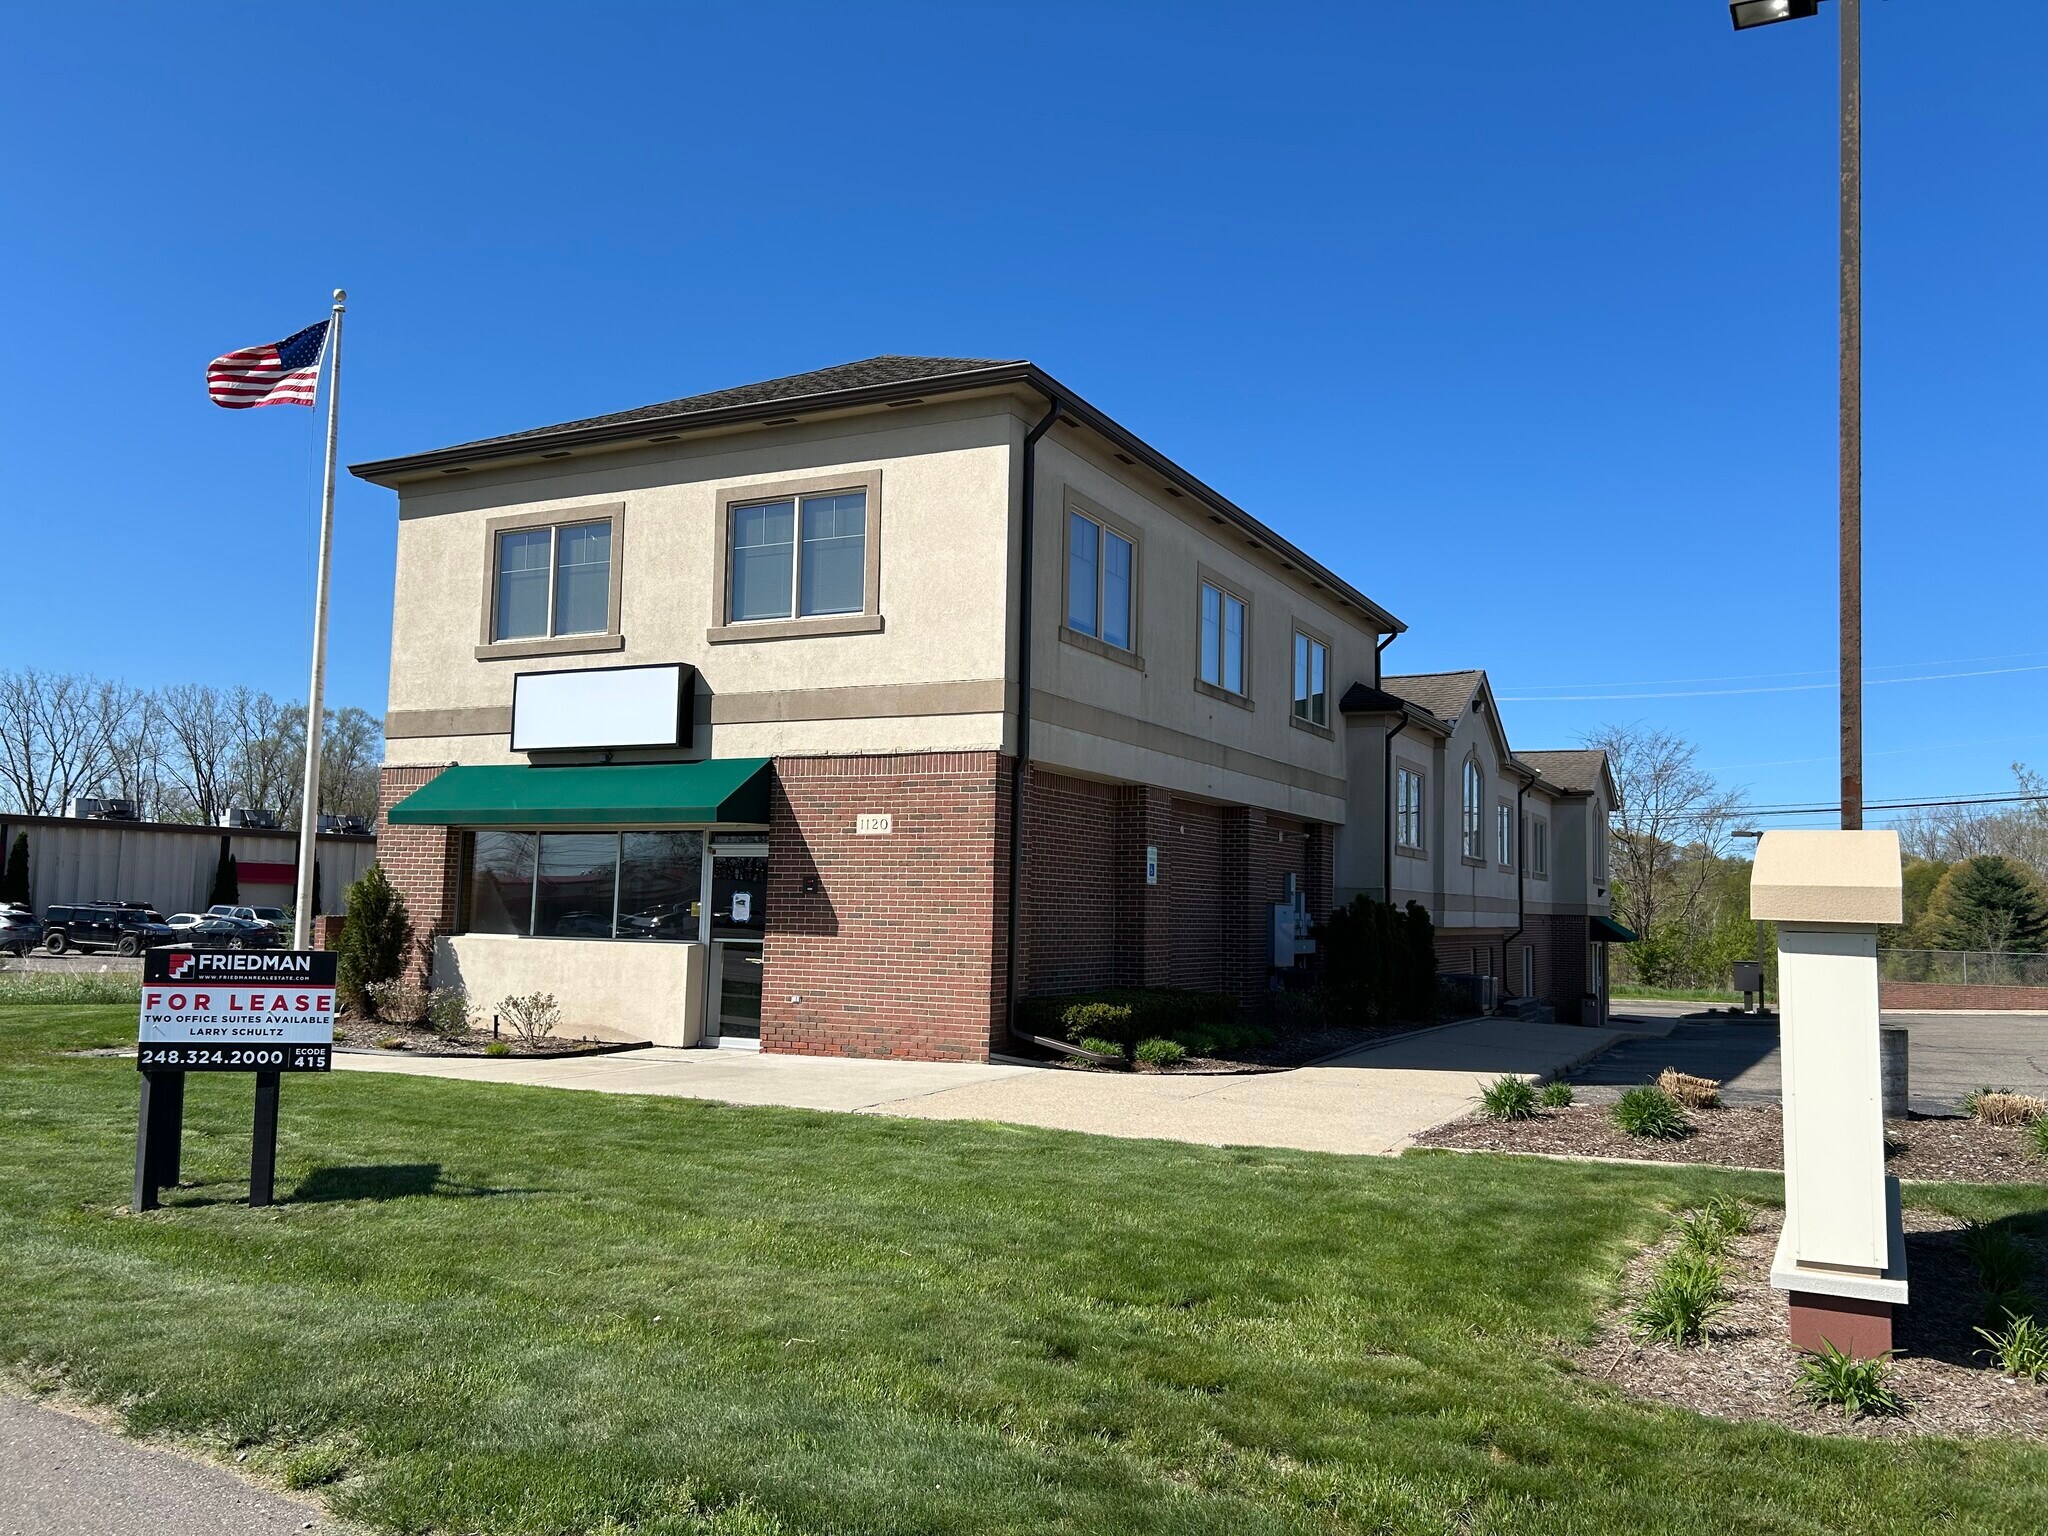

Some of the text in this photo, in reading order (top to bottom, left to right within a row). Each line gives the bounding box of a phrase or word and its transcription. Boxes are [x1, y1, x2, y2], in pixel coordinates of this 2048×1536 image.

[860, 818, 889, 830] 1120
[199, 954, 310, 971] FRIEDMAN
[147, 993, 331, 1011] FOR LEASE
[145, 1015, 330, 1024] TWO OFFICE SUITES AVAILABLE
[190, 1028, 284, 1036] LARRY SCHULTZ
[141, 1050, 283, 1064] 248.324.2000
[295, 1048, 326, 1056] ECODE
[294, 1056, 326, 1068] 415
